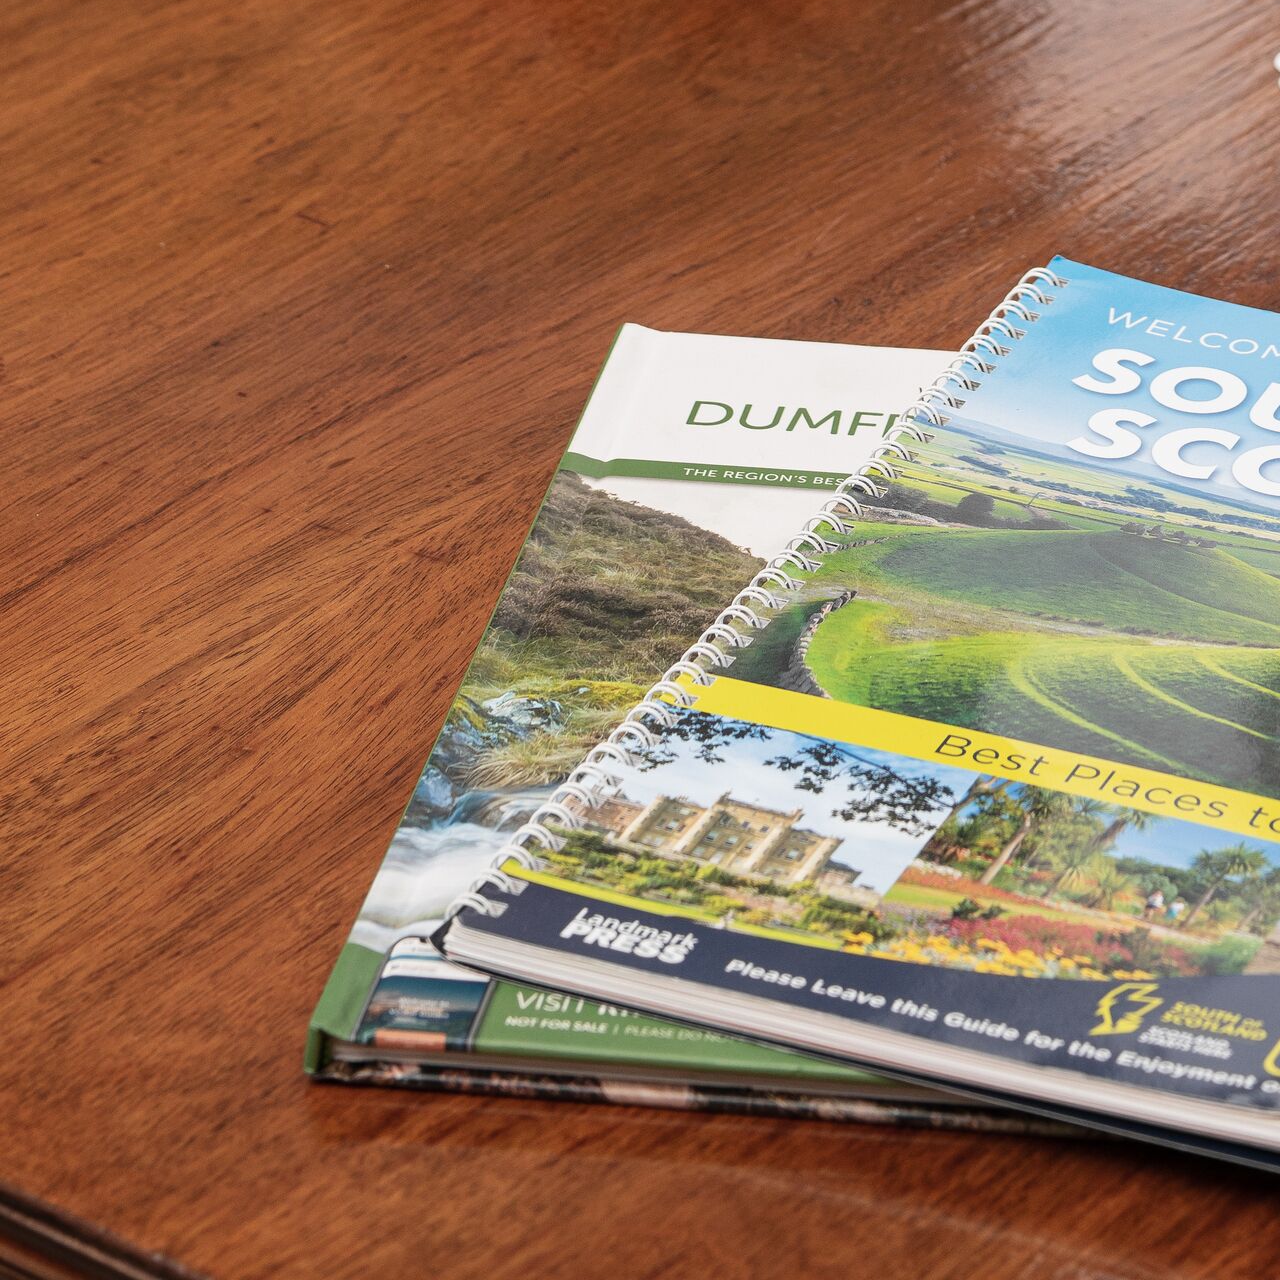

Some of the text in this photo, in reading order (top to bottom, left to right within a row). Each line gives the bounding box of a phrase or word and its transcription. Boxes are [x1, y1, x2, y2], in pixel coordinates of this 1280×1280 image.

[683, 467, 855, 487] THE REGION'S BES
[934, 734, 1049, 776] Best
[1066, 763, 1228, 819] Places
[560, 920, 688, 964] PRESS
[575, 907, 698, 950] Landmark
[505, 1015, 537, 1028] NOT
[540, 1019, 571, 1032] FOR
[572, 1020, 608, 1034] SALE
[624, 1025, 673, 1040] PLEASE
[725, 959, 807, 989] Please
[811, 979, 886, 1008] Leave
[891, 998, 939, 1022] this
[944, 1012, 1020, 1041] Guide
[1024, 1030, 1065, 1051] for
[1067, 1039, 1112, 1062] the
[1116, 1050, 1257, 1089] Enjoyment
